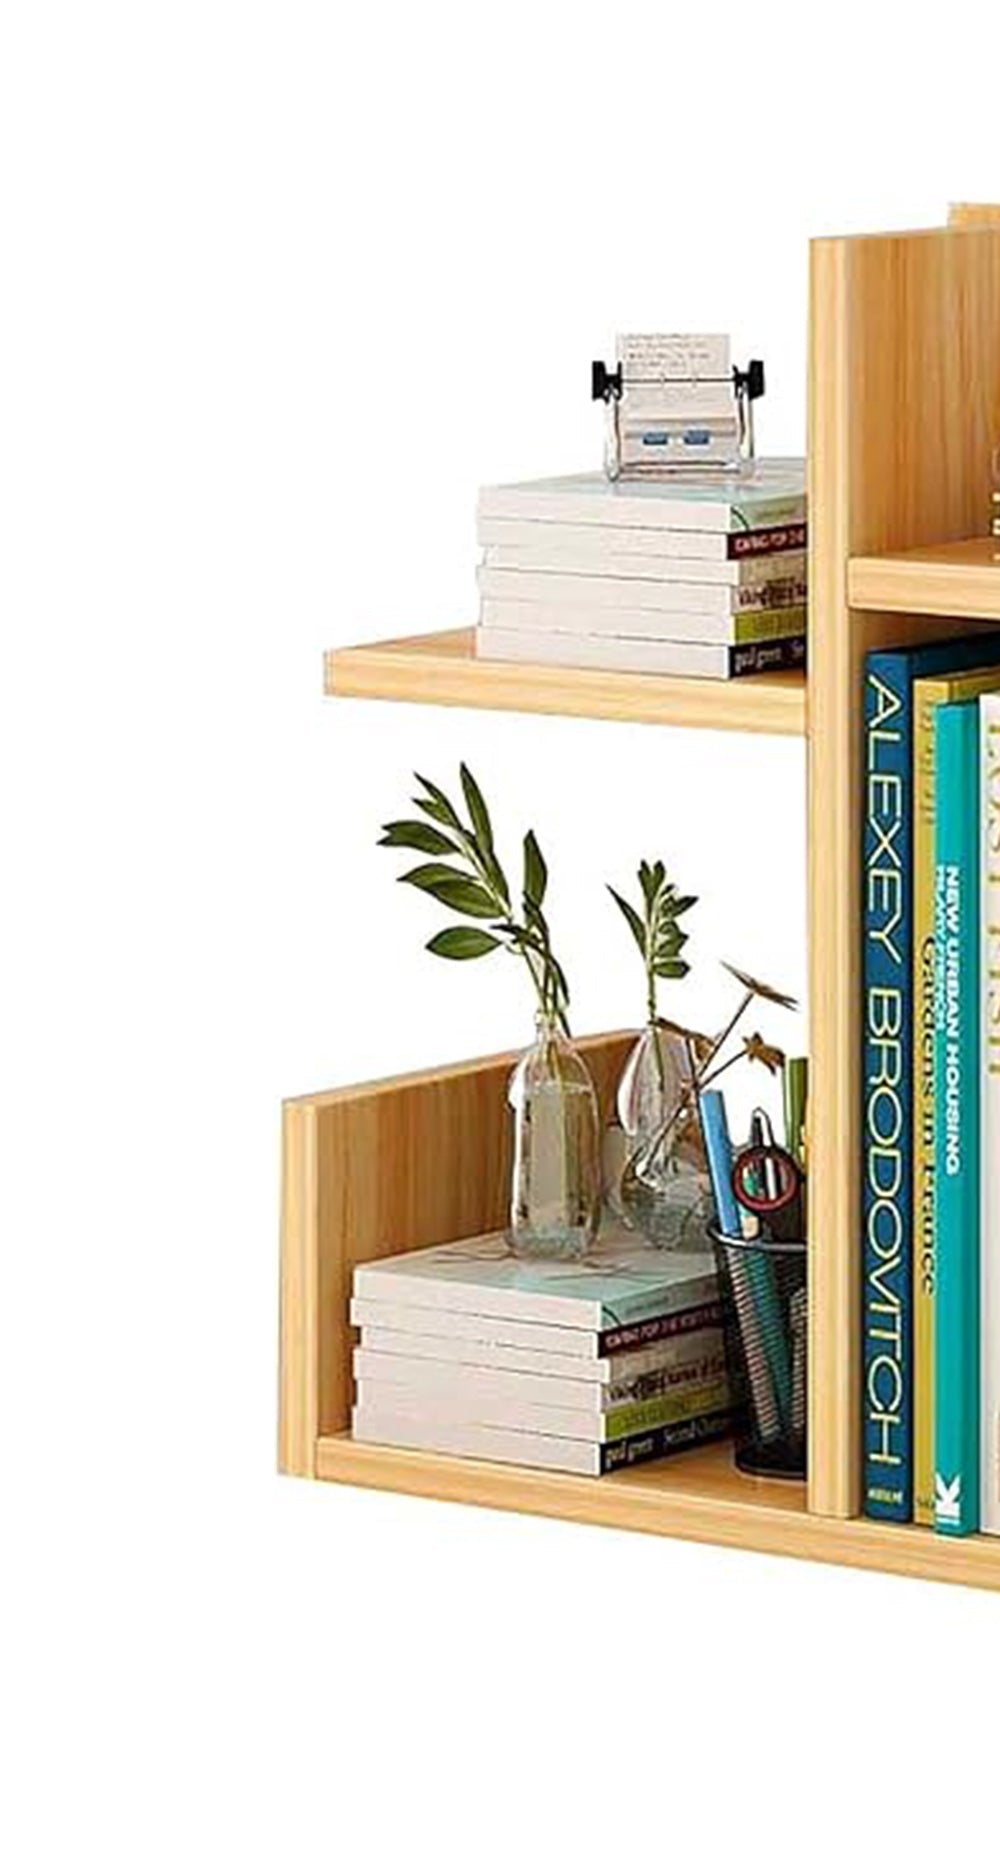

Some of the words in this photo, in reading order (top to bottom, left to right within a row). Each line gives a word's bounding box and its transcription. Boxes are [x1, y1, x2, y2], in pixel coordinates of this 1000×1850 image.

[867, 673, 902, 963] ALEXEY
[946, 865, 960, 933] NEW
[921, 935, 937, 1096] Gardens
[946, 937, 960, 1036] URBAN
[946, 1040, 960, 1176] HOUSING
[867, 985, 902, 1463] BRODOVITCH
